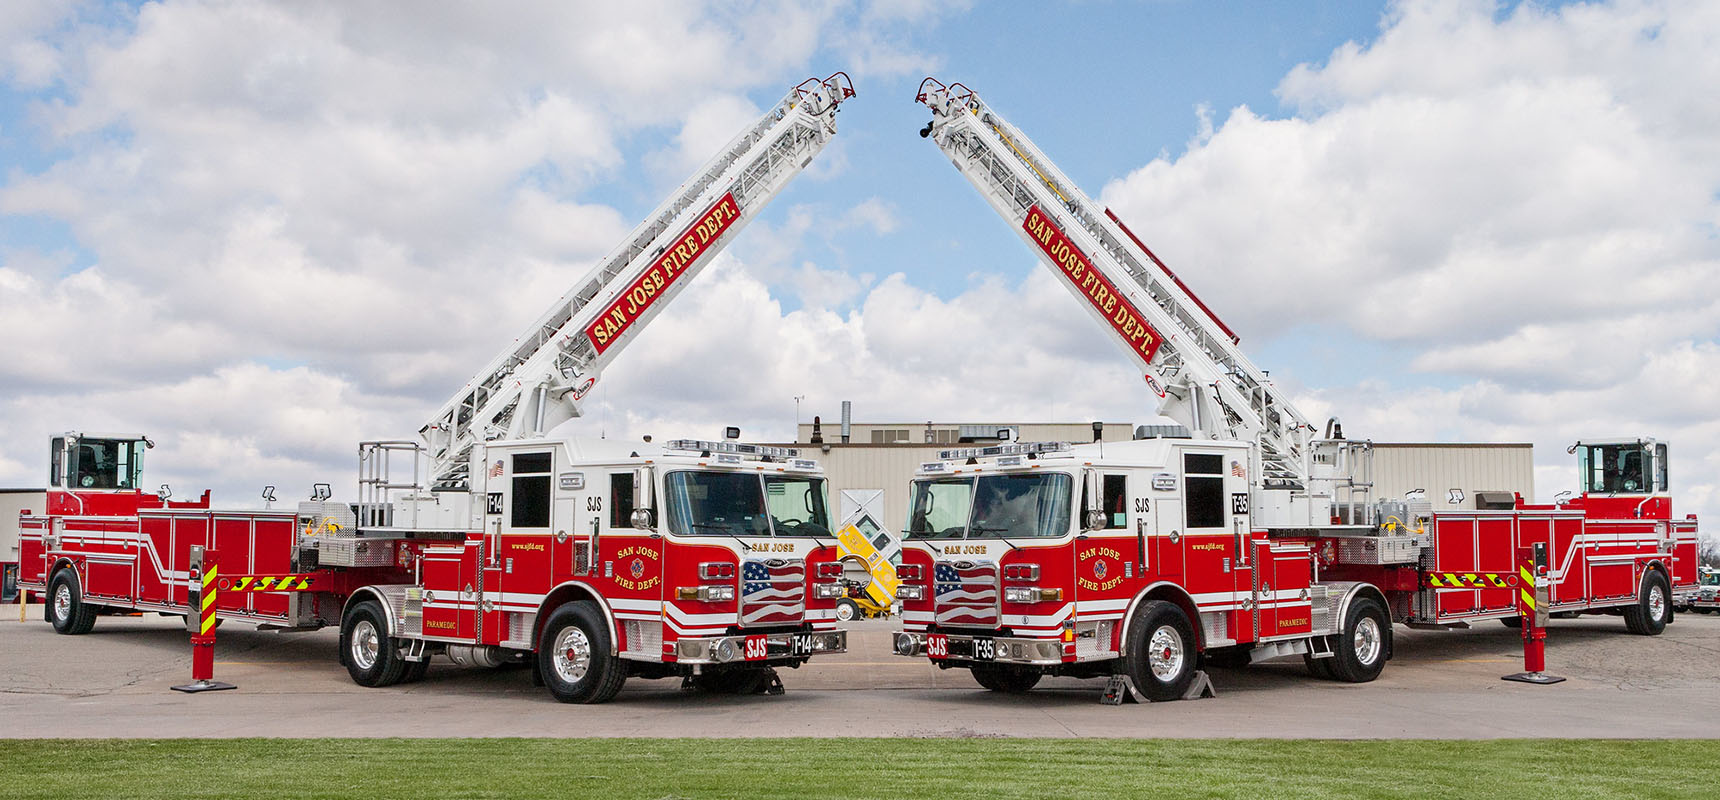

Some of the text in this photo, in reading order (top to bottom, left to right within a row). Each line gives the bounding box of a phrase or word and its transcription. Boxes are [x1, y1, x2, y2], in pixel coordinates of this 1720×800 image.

[593, 200, 736, 345] SAN JOSE FIRE DEPT.
[1027, 213, 1153, 356] SAN JOSE FIRE DEPT.
[488, 495, 503, 512] T-14
[587, 496, 602, 511] SJS
[1135, 497, 1149, 512] SJS
[1232, 495, 1248, 512] T-35
[511, 542, 544, 552] www.sjfd.org
[617, 546, 659, 561] SAN JOSE
[752, 543, 794, 552] SAN JOSE
[944, 545, 987, 554] SAN JOSE
[1079, 547, 1120, 561] SAN JOSE
[1192, 542, 1225, 551] www.sjfd.org
[614, 574, 661, 590] FIRE DEPT.
[1078, 575, 1124, 591] FIRE DEPT.
[426, 619, 456, 629] PARAMEDIC
[1279, 618, 1308, 628] PARAMEDIC
[747, 637, 767, 658] SJS
[793, 634, 812, 654] T-14
[928, 637, 946, 656] SJS
[973, 639, 994, 659] T-35
